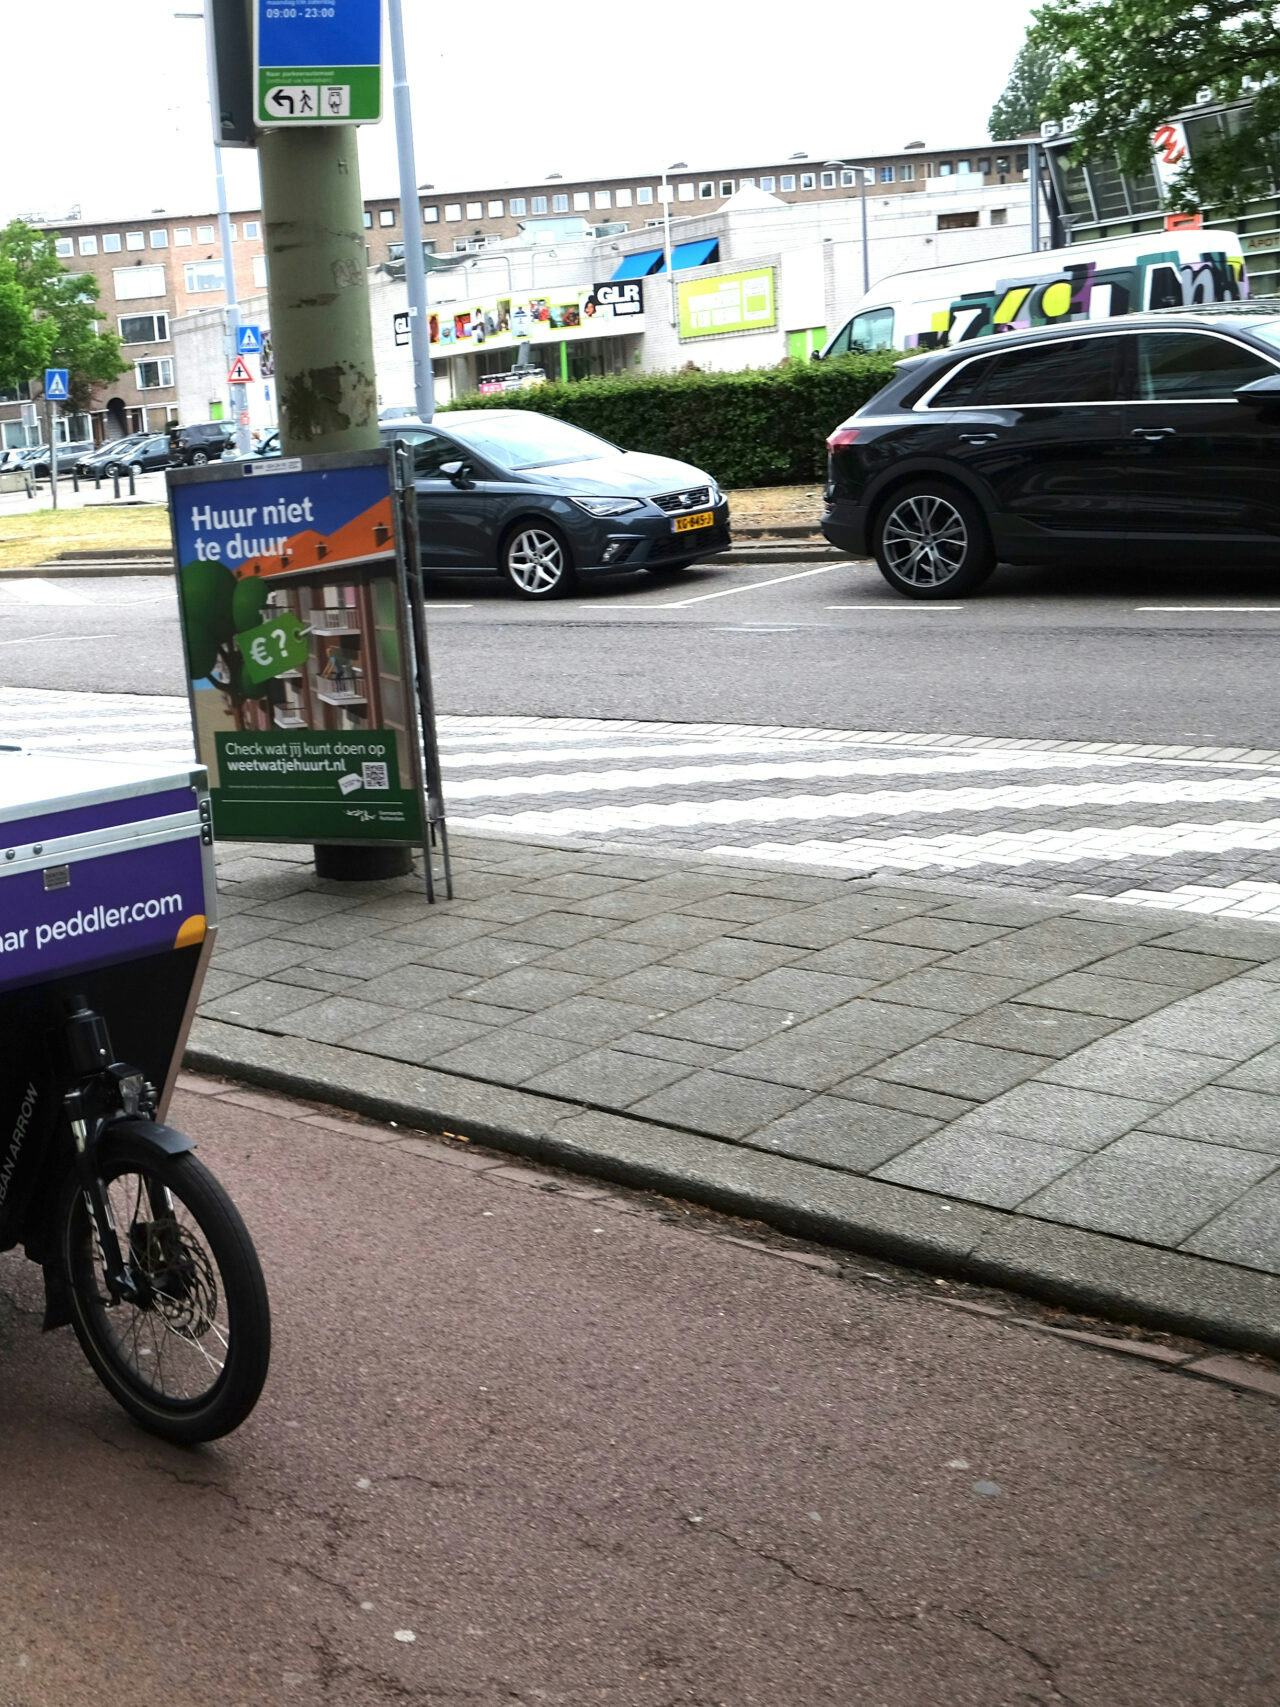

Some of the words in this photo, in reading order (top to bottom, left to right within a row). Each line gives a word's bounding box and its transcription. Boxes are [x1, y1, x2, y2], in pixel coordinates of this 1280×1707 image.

[266, 8, 297, 18] 09:00
[304, 8, 335, 18] 23:00
[597, 284, 640, 304] GLR
[395, 317, 410, 333] GL
[191, 505, 257, 531] Huur
[262, 496, 314, 525] niet
[194, 537, 221, 561] te
[226, 533, 293, 559] duur.
[225, 742, 263, 755] Check
[265, 744, 288, 755] wat
[289, 742, 302, 757] jij
[303, 743, 331, 755] kunt
[333, 743, 366, 755] doen
[368, 745, 385, 757] op
[227, 759, 346, 773] weetwatjehuurt.nl
[35, 893, 183, 949] peddler.com
[9, 1081, 39, 1161] ARROW
